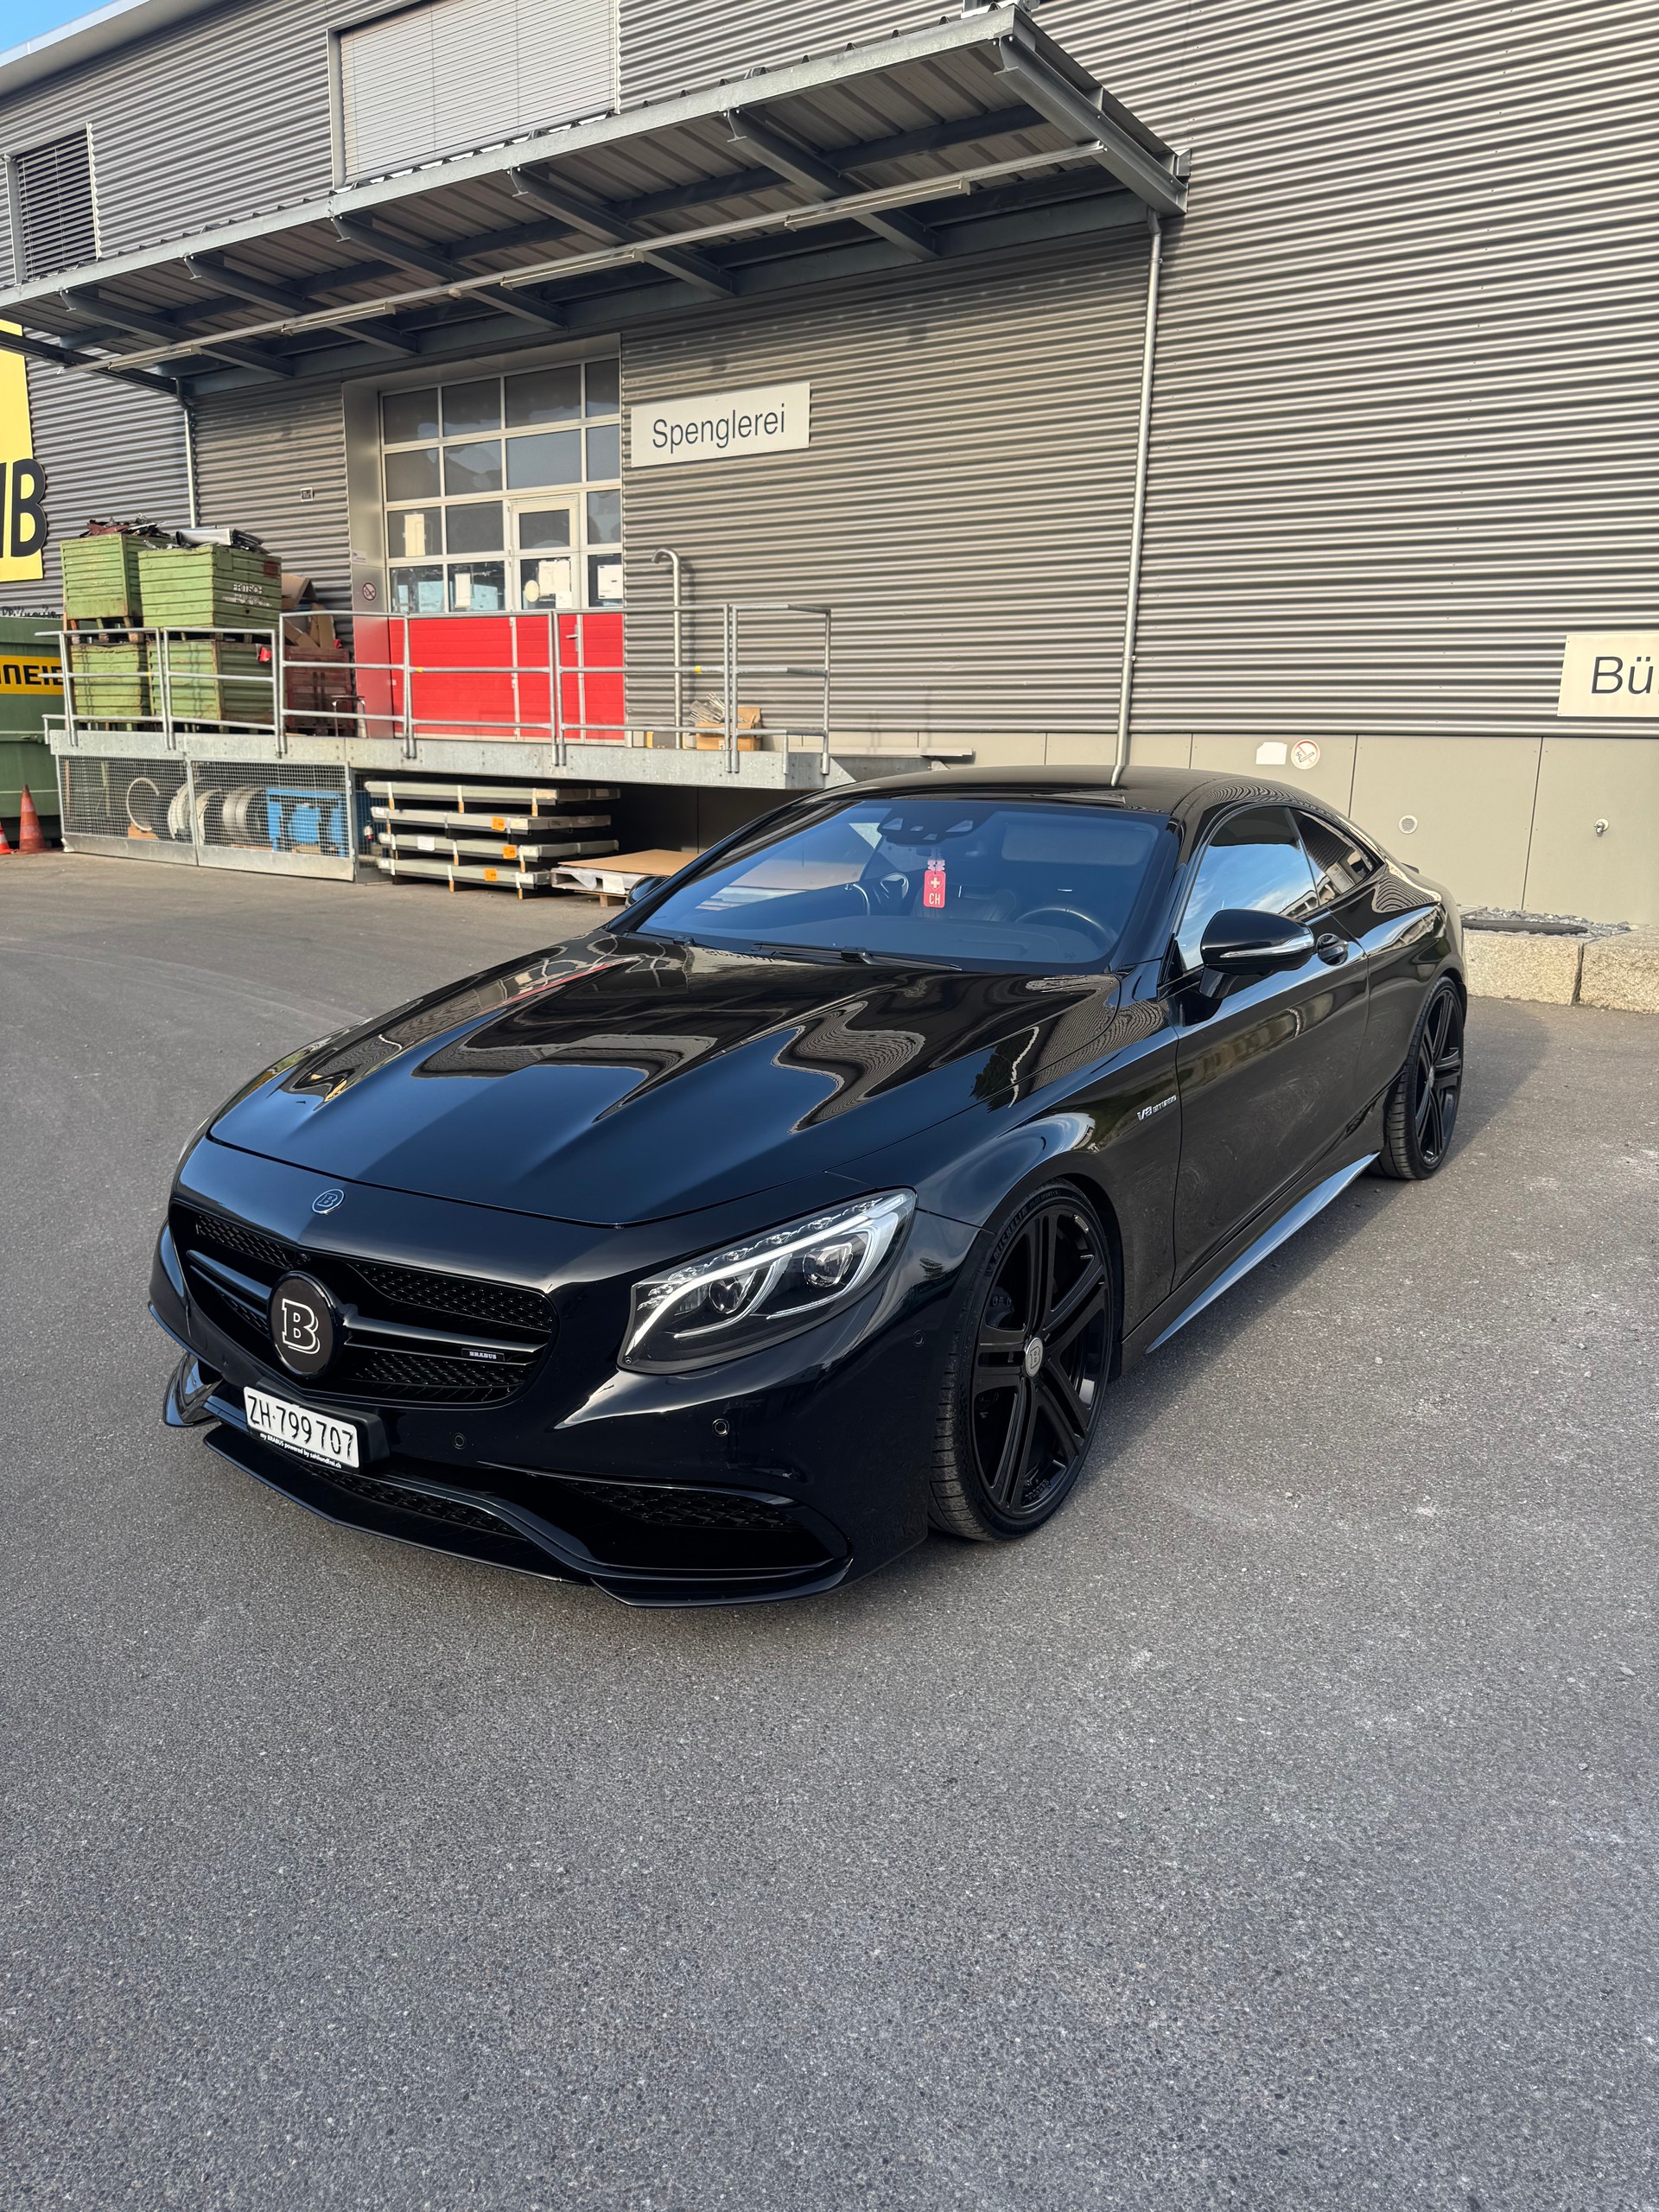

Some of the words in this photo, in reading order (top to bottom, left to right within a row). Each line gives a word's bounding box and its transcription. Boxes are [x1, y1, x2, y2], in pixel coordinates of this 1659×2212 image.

[652, 403, 785, 454] Spenglerei
[0, 458, 48, 557] B
[1591, 656, 1659, 695] Bü
[929, 893, 941, 906] CH
[1136, 1106, 1152, 1121] V8
[993, 1205, 1028, 1261] MICHELIN
[282, 1298, 321, 1355] B
[468, 1351, 497, 1360] BRABUS
[267, 1434, 284, 1446] BRABUS
[284, 1443, 303, 1454] powered
[303, 1448, 310, 1458] by
[315, 1420, 353, 1460] 707
